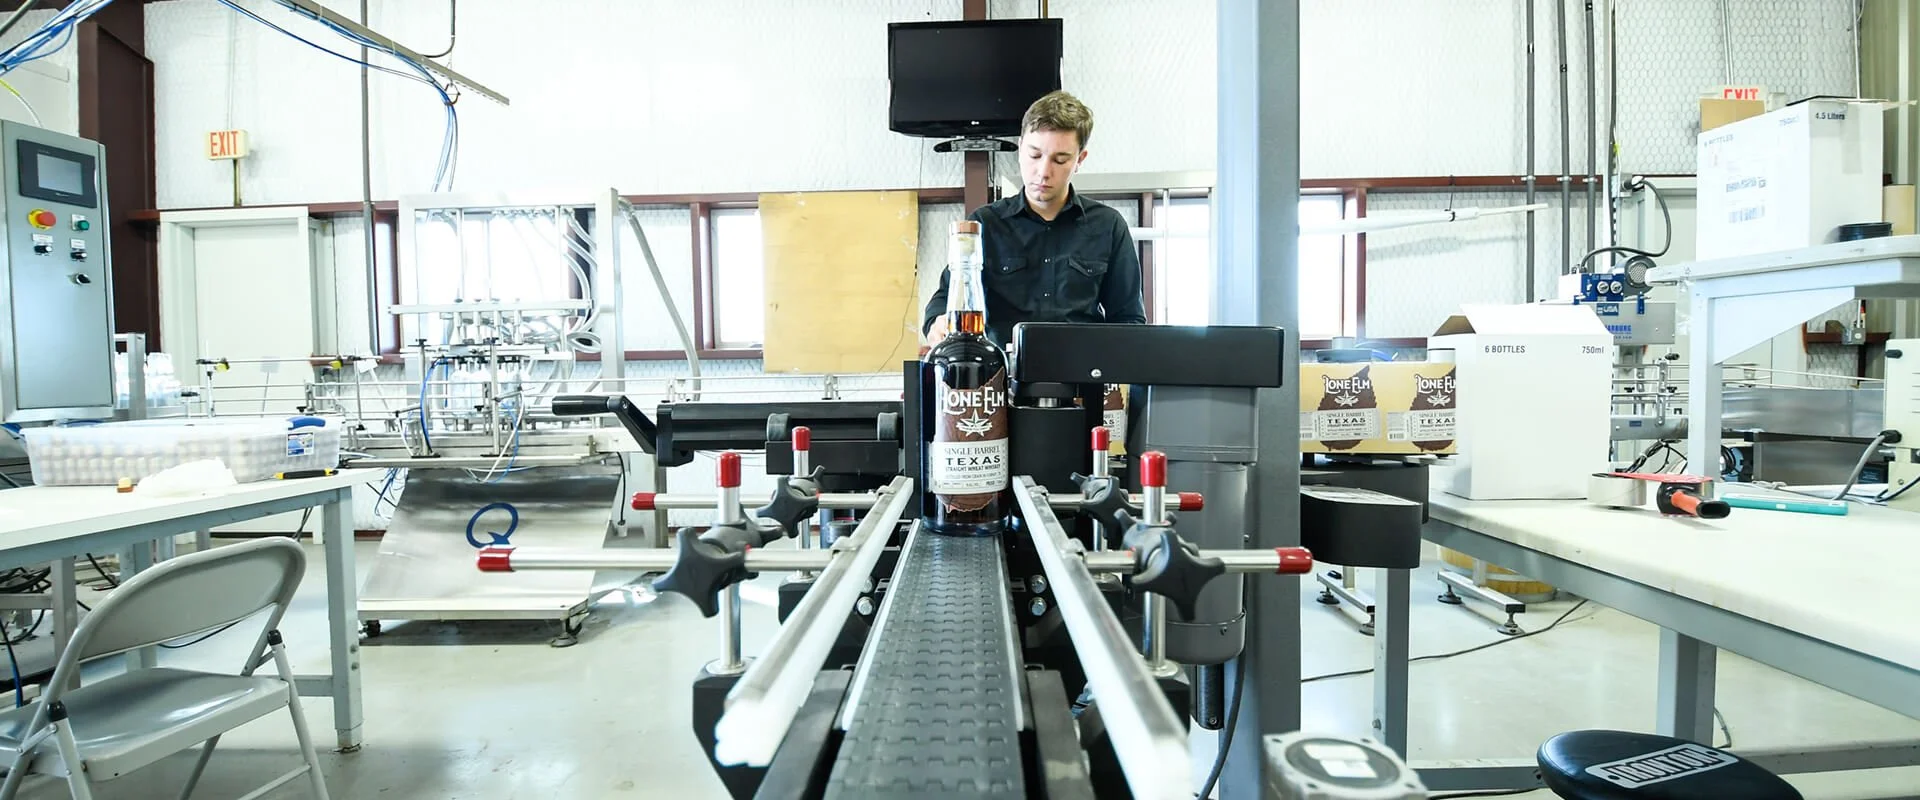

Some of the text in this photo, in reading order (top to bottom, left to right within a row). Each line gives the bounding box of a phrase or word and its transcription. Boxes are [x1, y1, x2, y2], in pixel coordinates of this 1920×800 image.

[1815, 112, 1826, 120] 4.5
[210, 131, 238, 156] EXIT
[1603, 305, 1618, 313] USA
[1484, 345, 1526, 353] 6 BOTTLES
[1581, 346, 1604, 354] 750ml
[1322, 375, 1370, 394] LONE ELM
[1415, 374, 1443, 394] LONE
[943, 384, 1005, 415] LONE ELM
[944, 445, 1001, 455] SINGLE BARREL
[945, 455, 1001, 465] TEXAS
[1606, 748, 1720, 782] IRONTON
